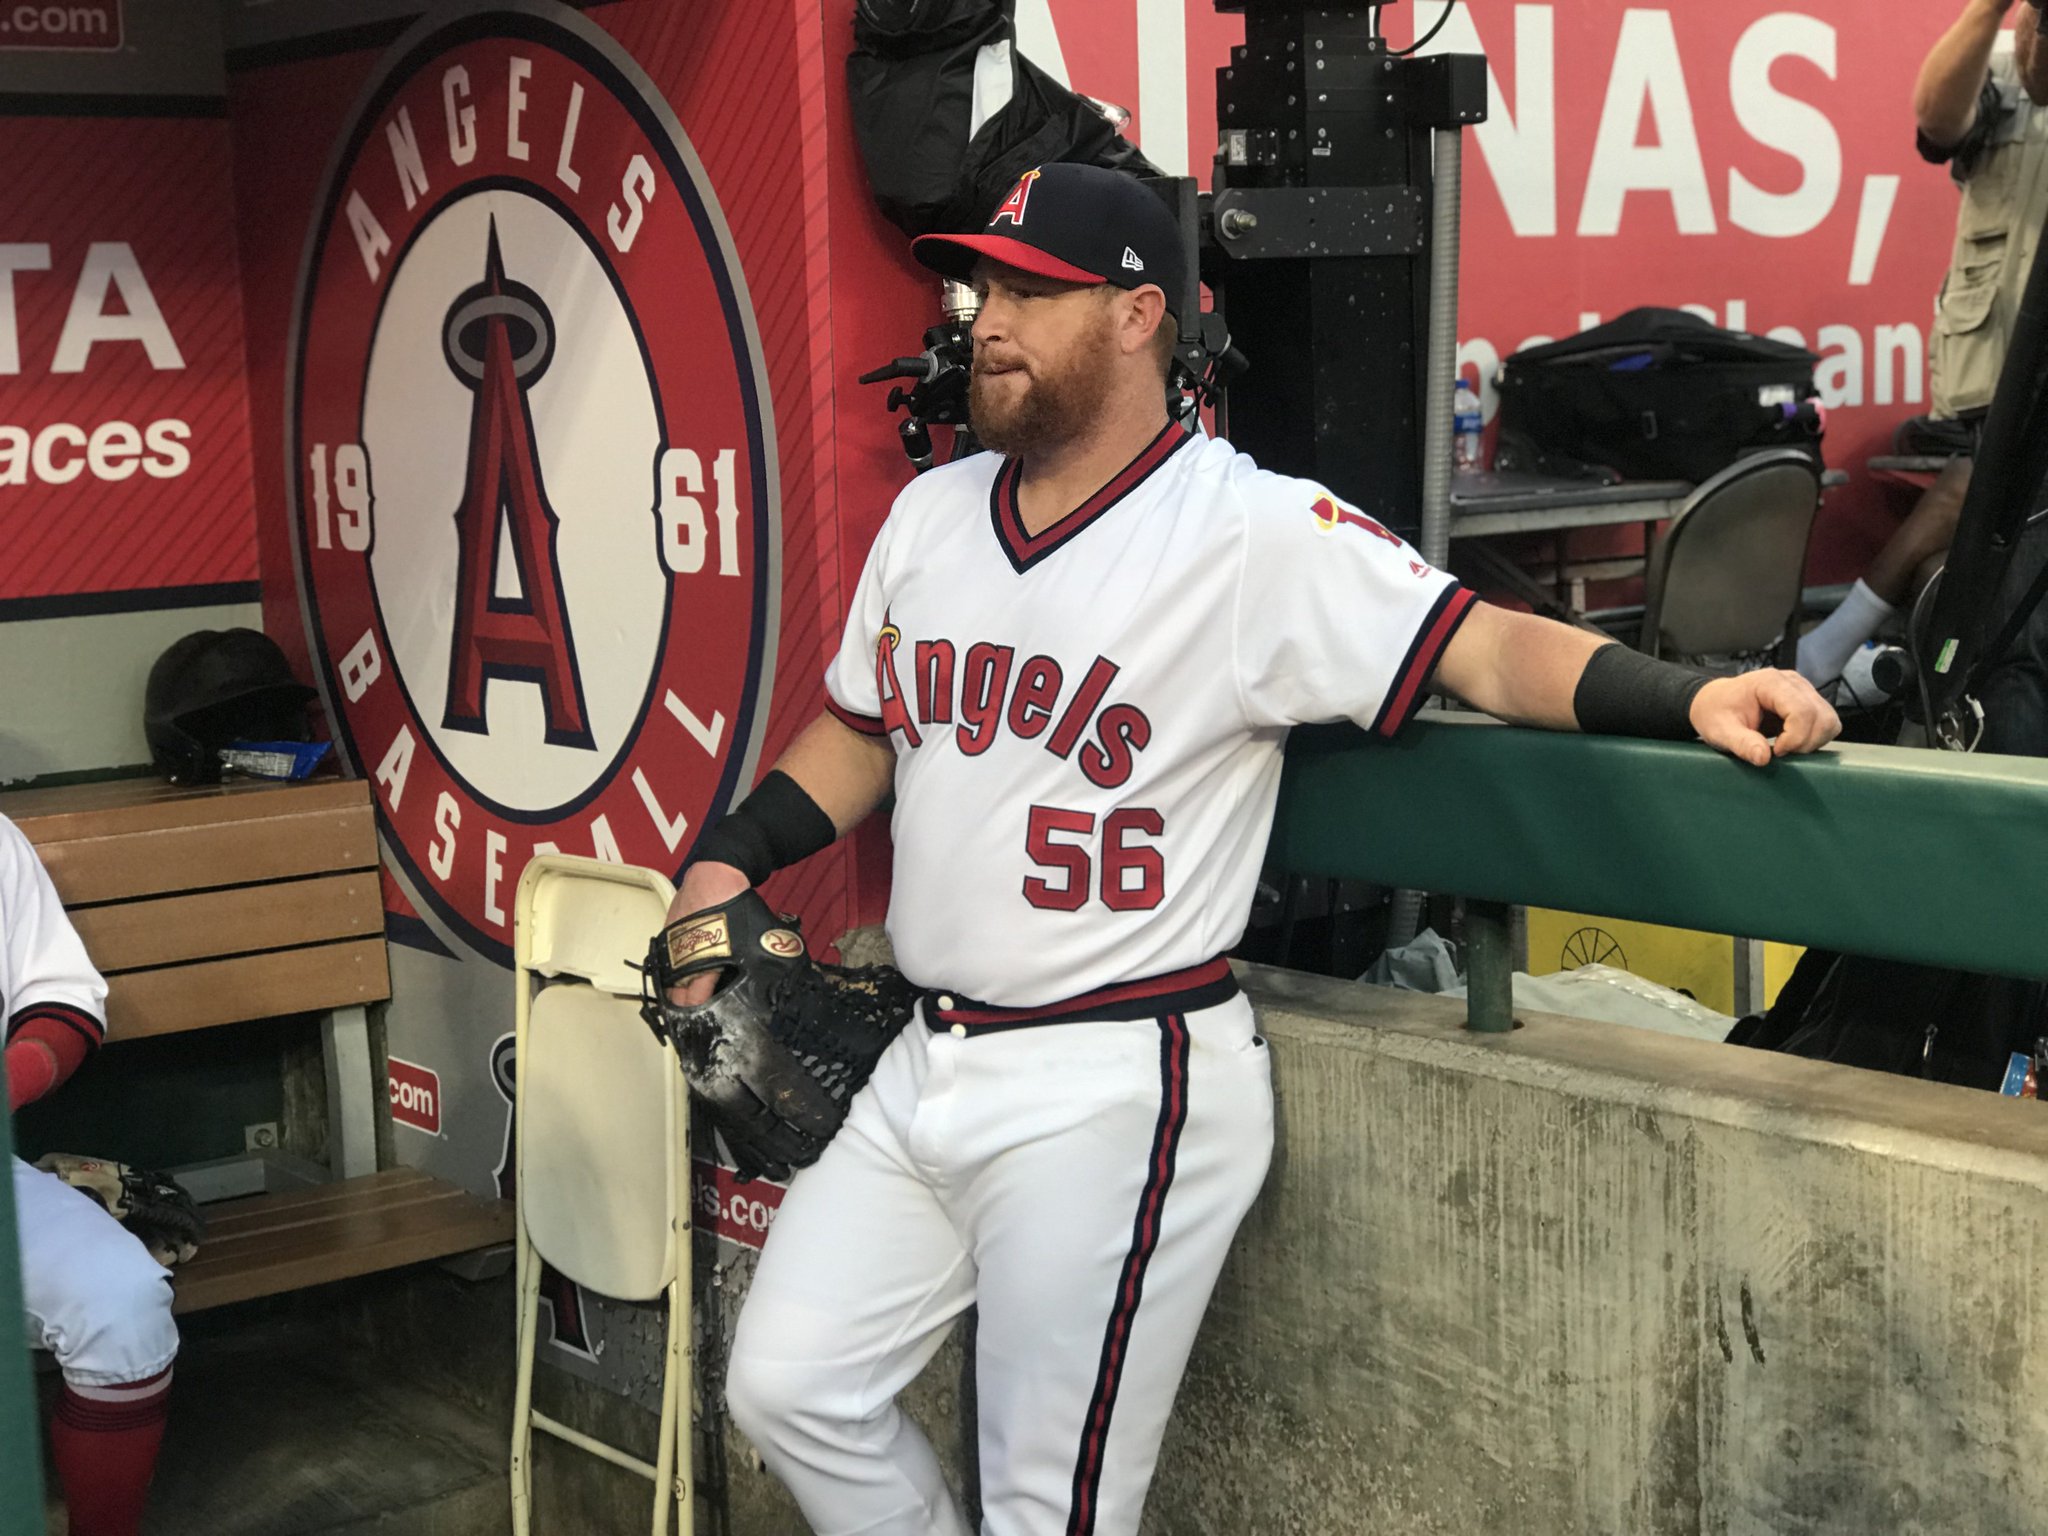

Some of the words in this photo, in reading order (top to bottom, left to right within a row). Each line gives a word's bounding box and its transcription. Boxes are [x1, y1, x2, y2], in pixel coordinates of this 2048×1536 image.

[345, 56, 656, 284] ANGELS
[337, 628, 726, 928] BASEALL
[875, 600, 1151, 789] Angels
[1022, 804, 1166, 912] 56
